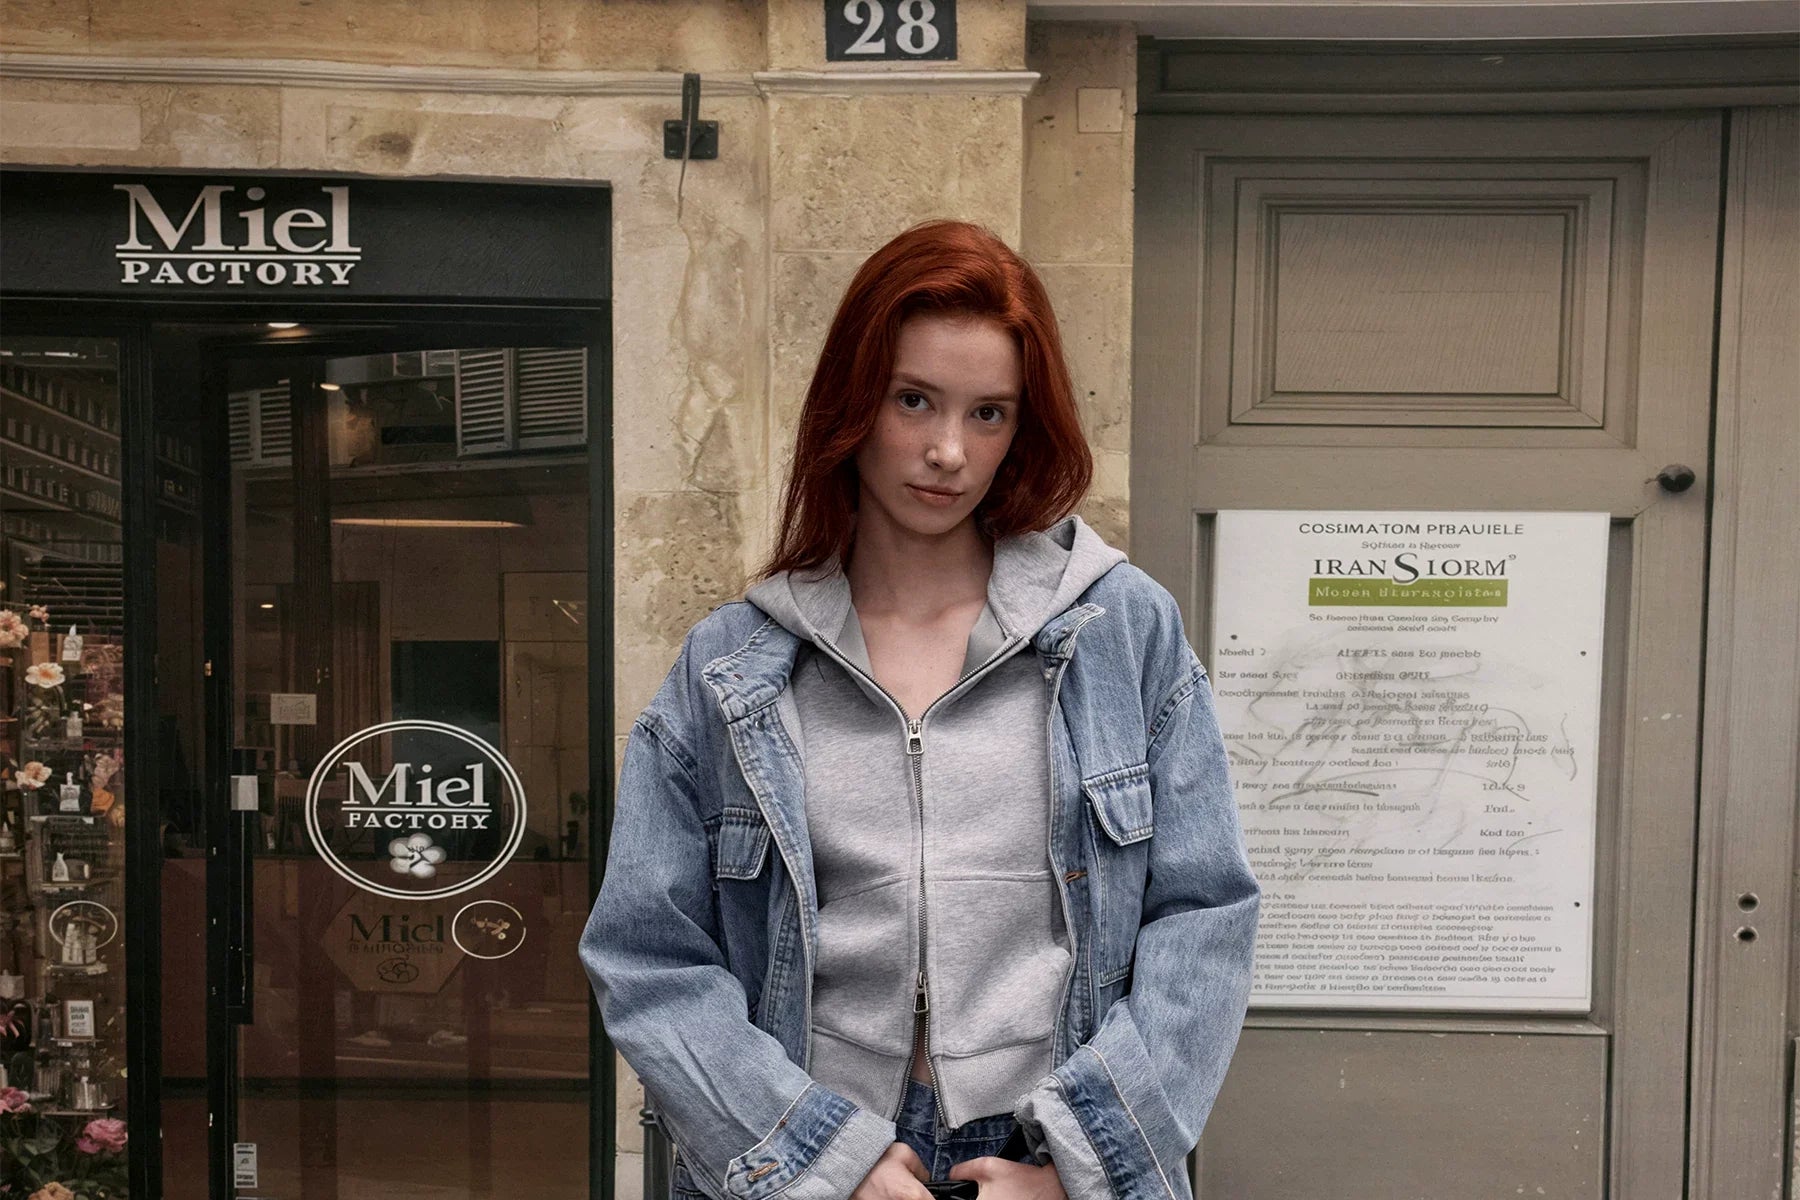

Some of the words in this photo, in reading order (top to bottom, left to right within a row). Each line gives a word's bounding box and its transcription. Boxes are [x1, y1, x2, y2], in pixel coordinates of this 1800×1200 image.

[843, 0, 940, 55] 28
[113, 184, 362, 253] Miel
[342, 761, 490, 807] Miel
